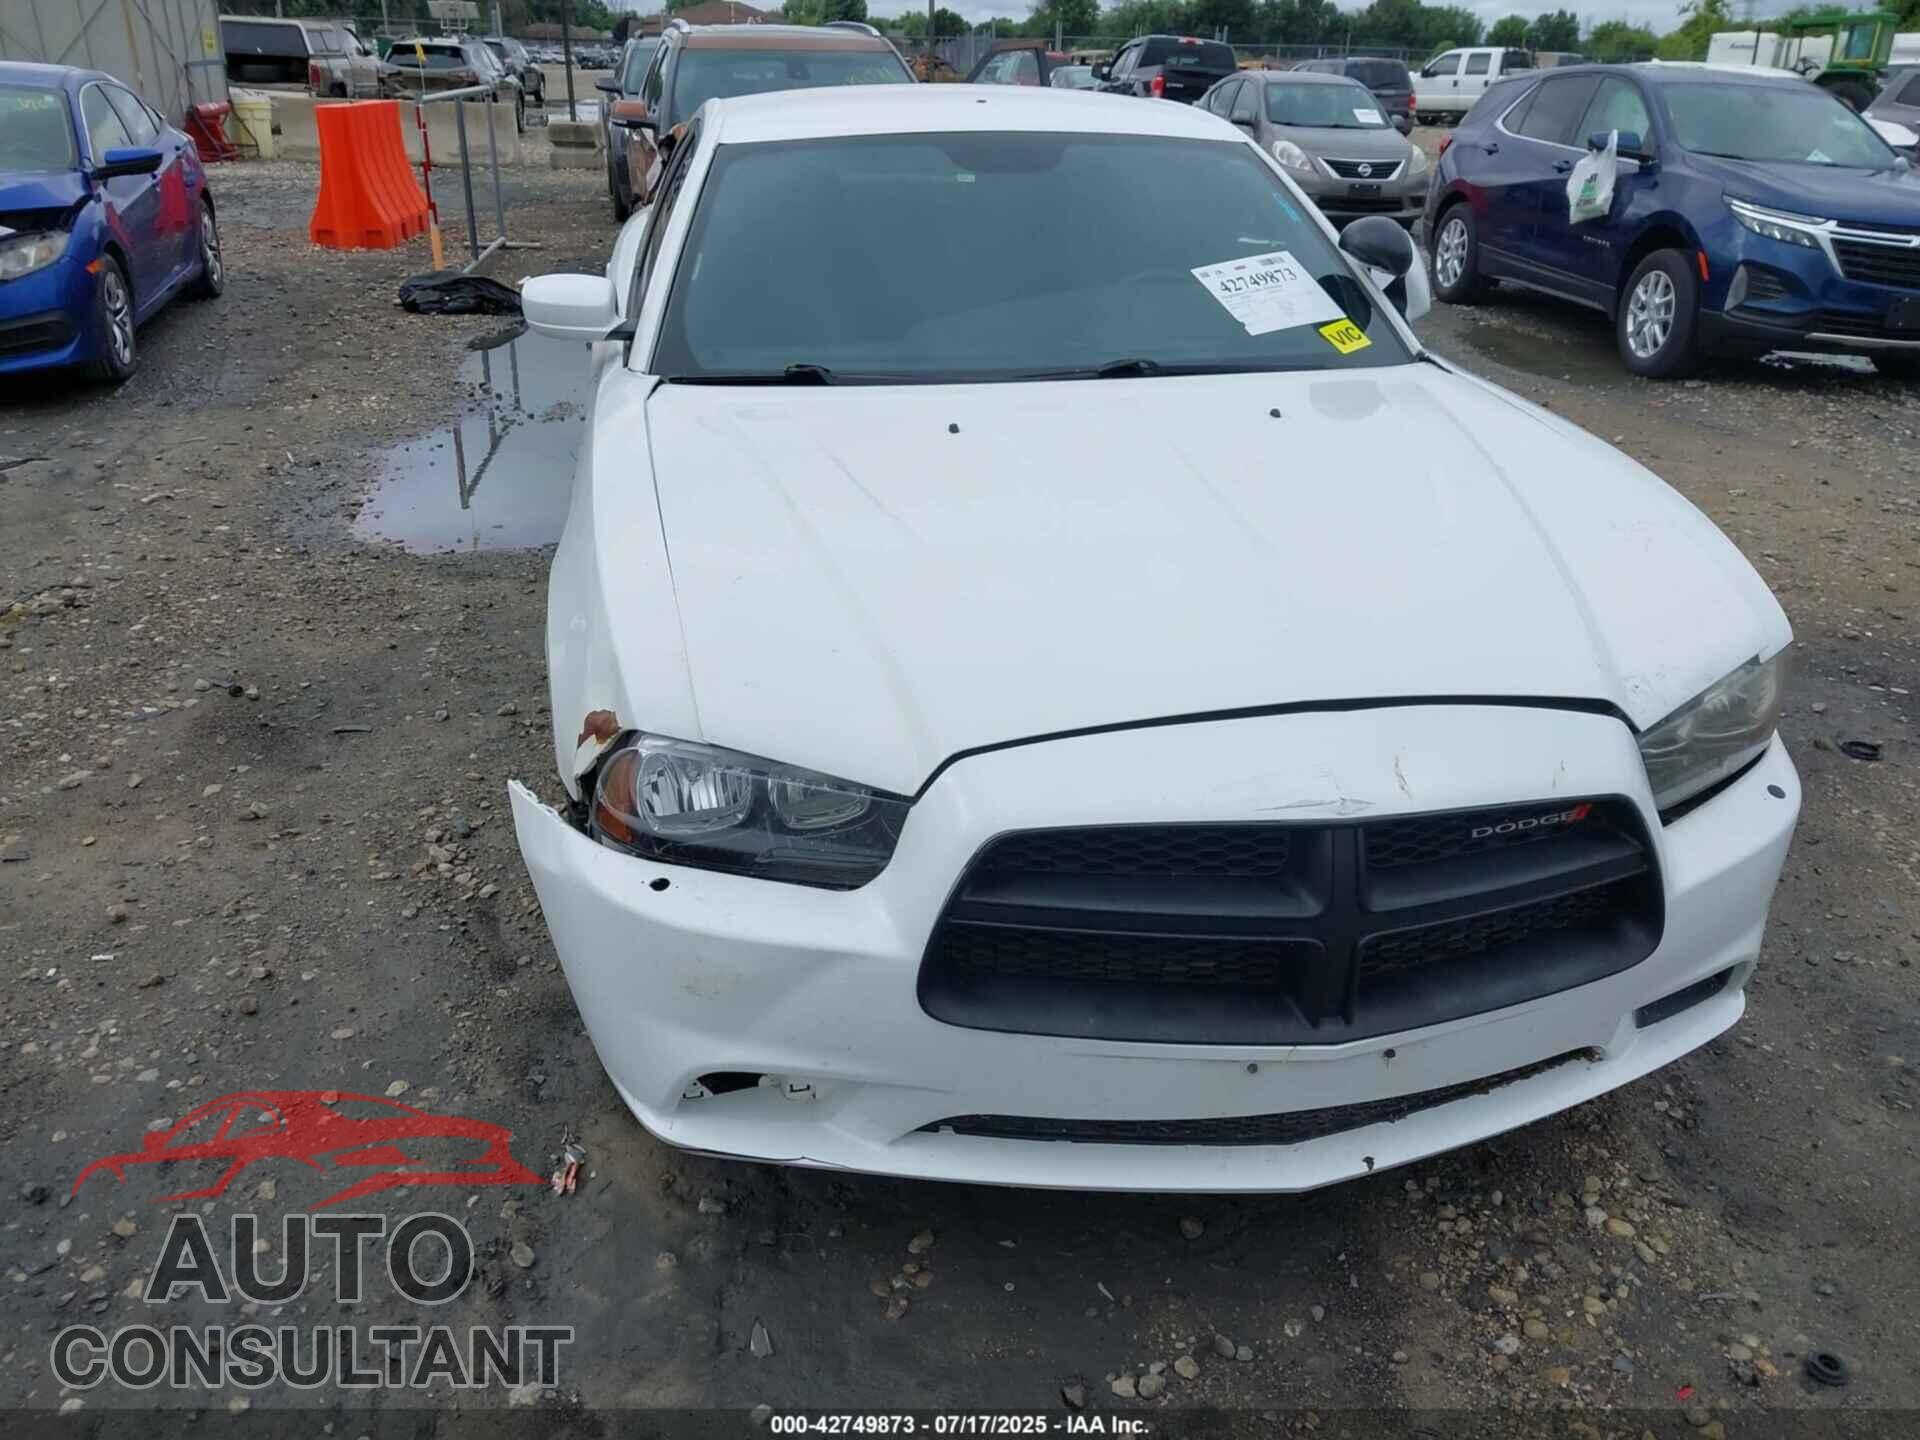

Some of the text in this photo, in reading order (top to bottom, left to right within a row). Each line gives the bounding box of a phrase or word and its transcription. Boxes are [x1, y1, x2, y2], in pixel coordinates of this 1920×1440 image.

[1220, 267, 1297, 292] 42749873
[1329, 327, 1363, 346] VIC
[1472, 811, 1574, 838] DODGE
